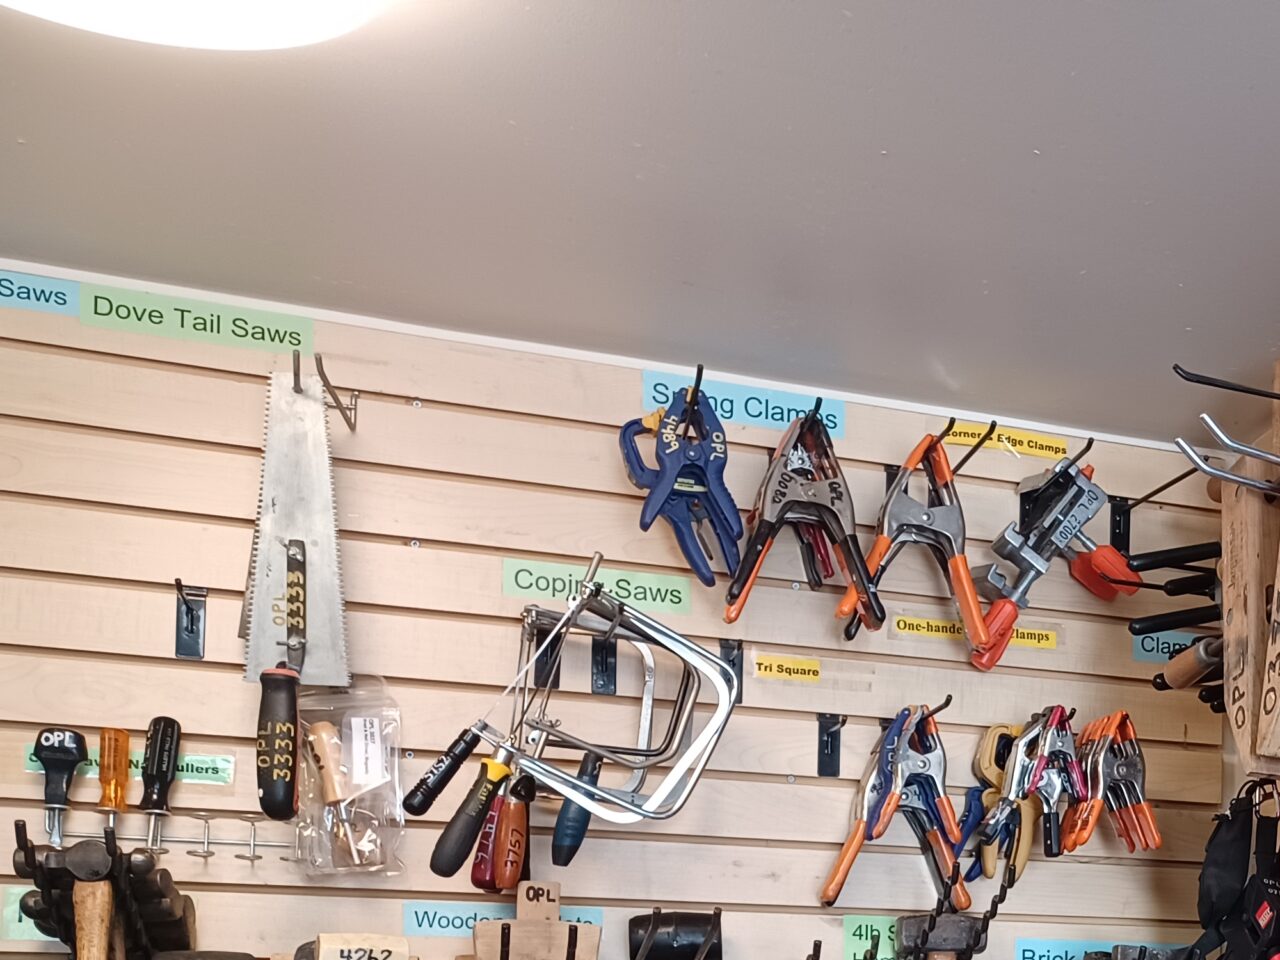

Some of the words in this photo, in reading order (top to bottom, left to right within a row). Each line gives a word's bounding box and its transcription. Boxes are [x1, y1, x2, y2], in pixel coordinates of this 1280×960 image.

[0, 278, 67, 306] Saws
[93, 295, 164, 325] Dove
[173, 307, 221, 335] Tail
[231, 318, 302, 347] Saws
[652, 382, 734, 420] Sng
[710, 432, 725, 461] OPL
[997, 434, 1024, 447] Edge
[1027, 440, 1067, 455] Clamps
[1084, 489, 1099, 511] OPL
[515, 568, 604, 598] Copi
[615, 579, 682, 604] Saws
[272, 594, 286, 626] OPL
[896, 619, 963, 635] One-hande
[1140, 634, 1190, 658] Clam
[756, 661, 783, 674] Tri
[786, 663, 820, 678] Square
[1233, 655, 1247, 730] OPL
[40, 731, 77, 748] OPL
[257, 720, 272, 768] OPL
[273, 721, 295, 783] 3333
[173, 761, 219, 775] ullers
[525, 886, 556, 903] OPL
[414, 910, 503, 930] Wood
